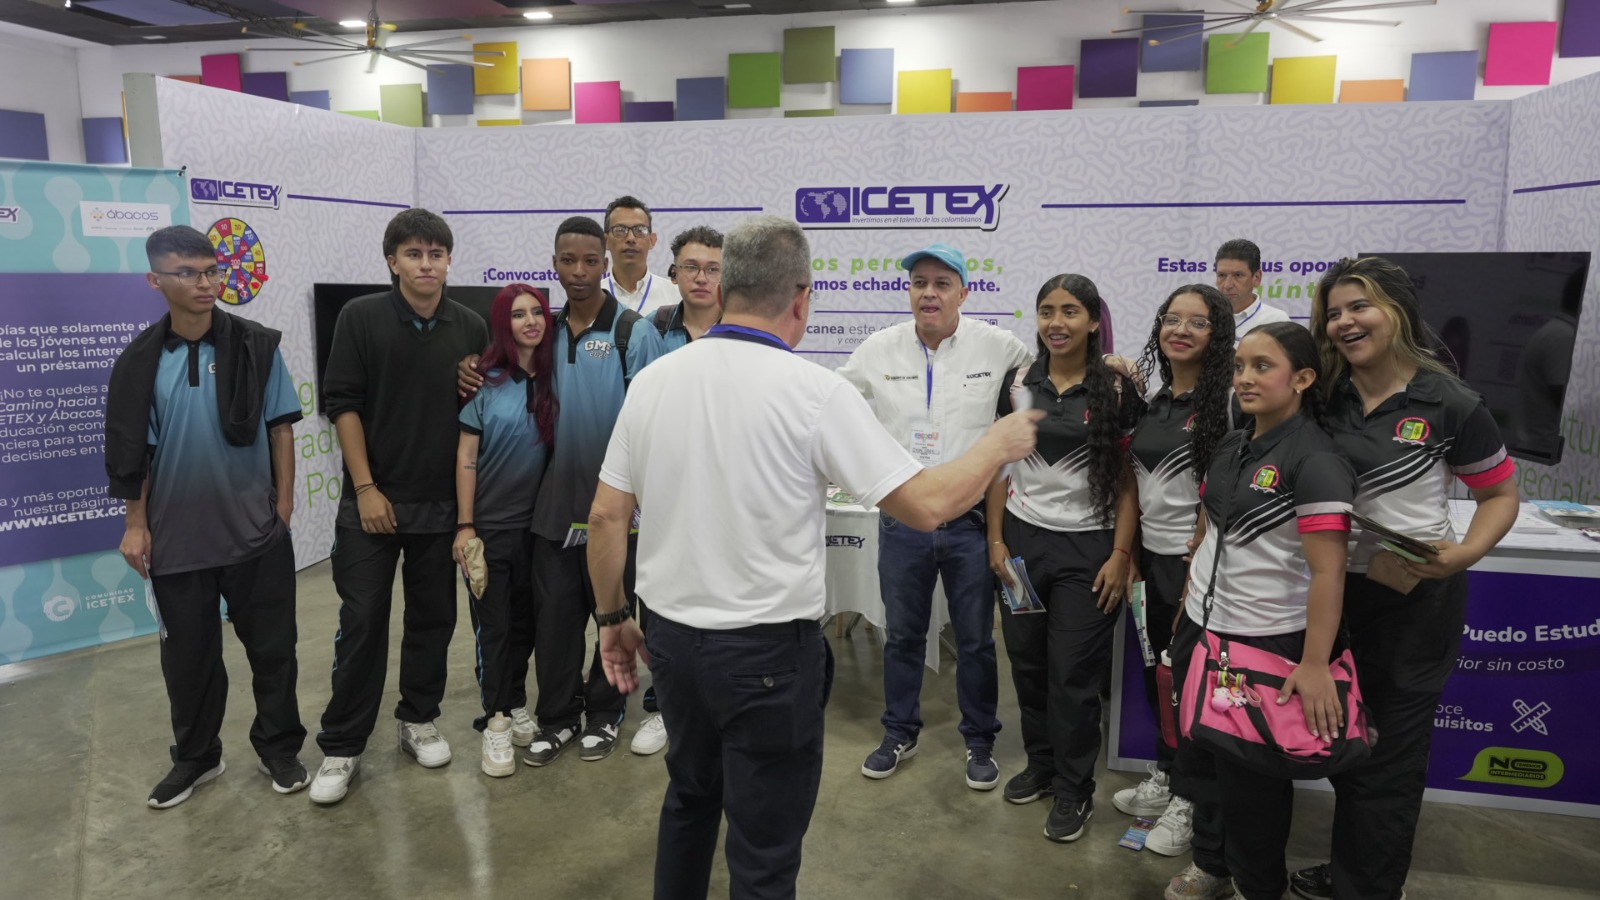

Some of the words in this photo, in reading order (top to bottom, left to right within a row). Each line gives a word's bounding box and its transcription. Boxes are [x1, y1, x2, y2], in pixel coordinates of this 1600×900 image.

[218, 180, 279, 206] ICETEX
[853, 184, 1003, 223] ICETEX
[0, 208, 18, 222] EX
[107, 209, 159, 220] ábacos
[812, 258, 839, 271] os
[1158, 258, 1207, 272] Estas
[1262, 262, 1283, 272] us
[1289, 261, 1338, 275] opor
[483, 268, 560, 283] ¡Convocato
[812, 280, 847, 290] mos
[853, 277, 911, 291] echado
[1256, 278, 1316, 298] únt
[30, 325, 58, 337] que
[62, 322, 135, 334] solamente
[138, 321, 150, 331] el
[806, 325, 844, 334] canea
[849, 324, 876, 334] este
[16, 337, 38, 347] los
[40, 335, 96, 349] jóvenes
[99, 335, 117, 345] en
[120, 333, 132, 343] el
[60, 348, 80, 358] los
[83, 346, 125, 357] intere
[16, 363, 36, 373] un
[41, 358, 115, 374] préstamo?
[28, 388, 42, 397] te
[46, 384, 98, 398] quedes
[101, 384, 109, 392] a
[58, 396, 97, 408] hacia
[101, 396, 106, 404] t
[0, 413, 34, 425] ETEX
[37, 413, 46, 424] y
[49, 409, 104, 421] Ábacos,
[0, 423, 65, 437] ducación
[0, 439, 39, 450] nciera
[45, 436, 74, 448] para
[79, 433, 105, 443] tom
[2, 450, 77, 463] decisiones
[80, 446, 97, 455] en
[307, 472, 340, 508] Po
[11, 497, 20, 507] y
[24, 491, 54, 504] más
[14, 502, 67, 517] nuestra
[72, 496, 118, 511] página
[86, 588, 134, 600] COMUNIDAD
[87, 594, 135, 609] ICETEX
[1535, 619, 1600, 641] Estud
[1457, 656, 1482, 670] ior
[1487, 658, 1512, 671] sin
[1517, 657, 1565, 671] costo
[1436, 704, 1463, 715] oce
[1434, 715, 1494, 732] uisitos
[1490, 757, 1547, 772] NO
[1490, 770, 1545, 780] INTERMEDIARIOS
